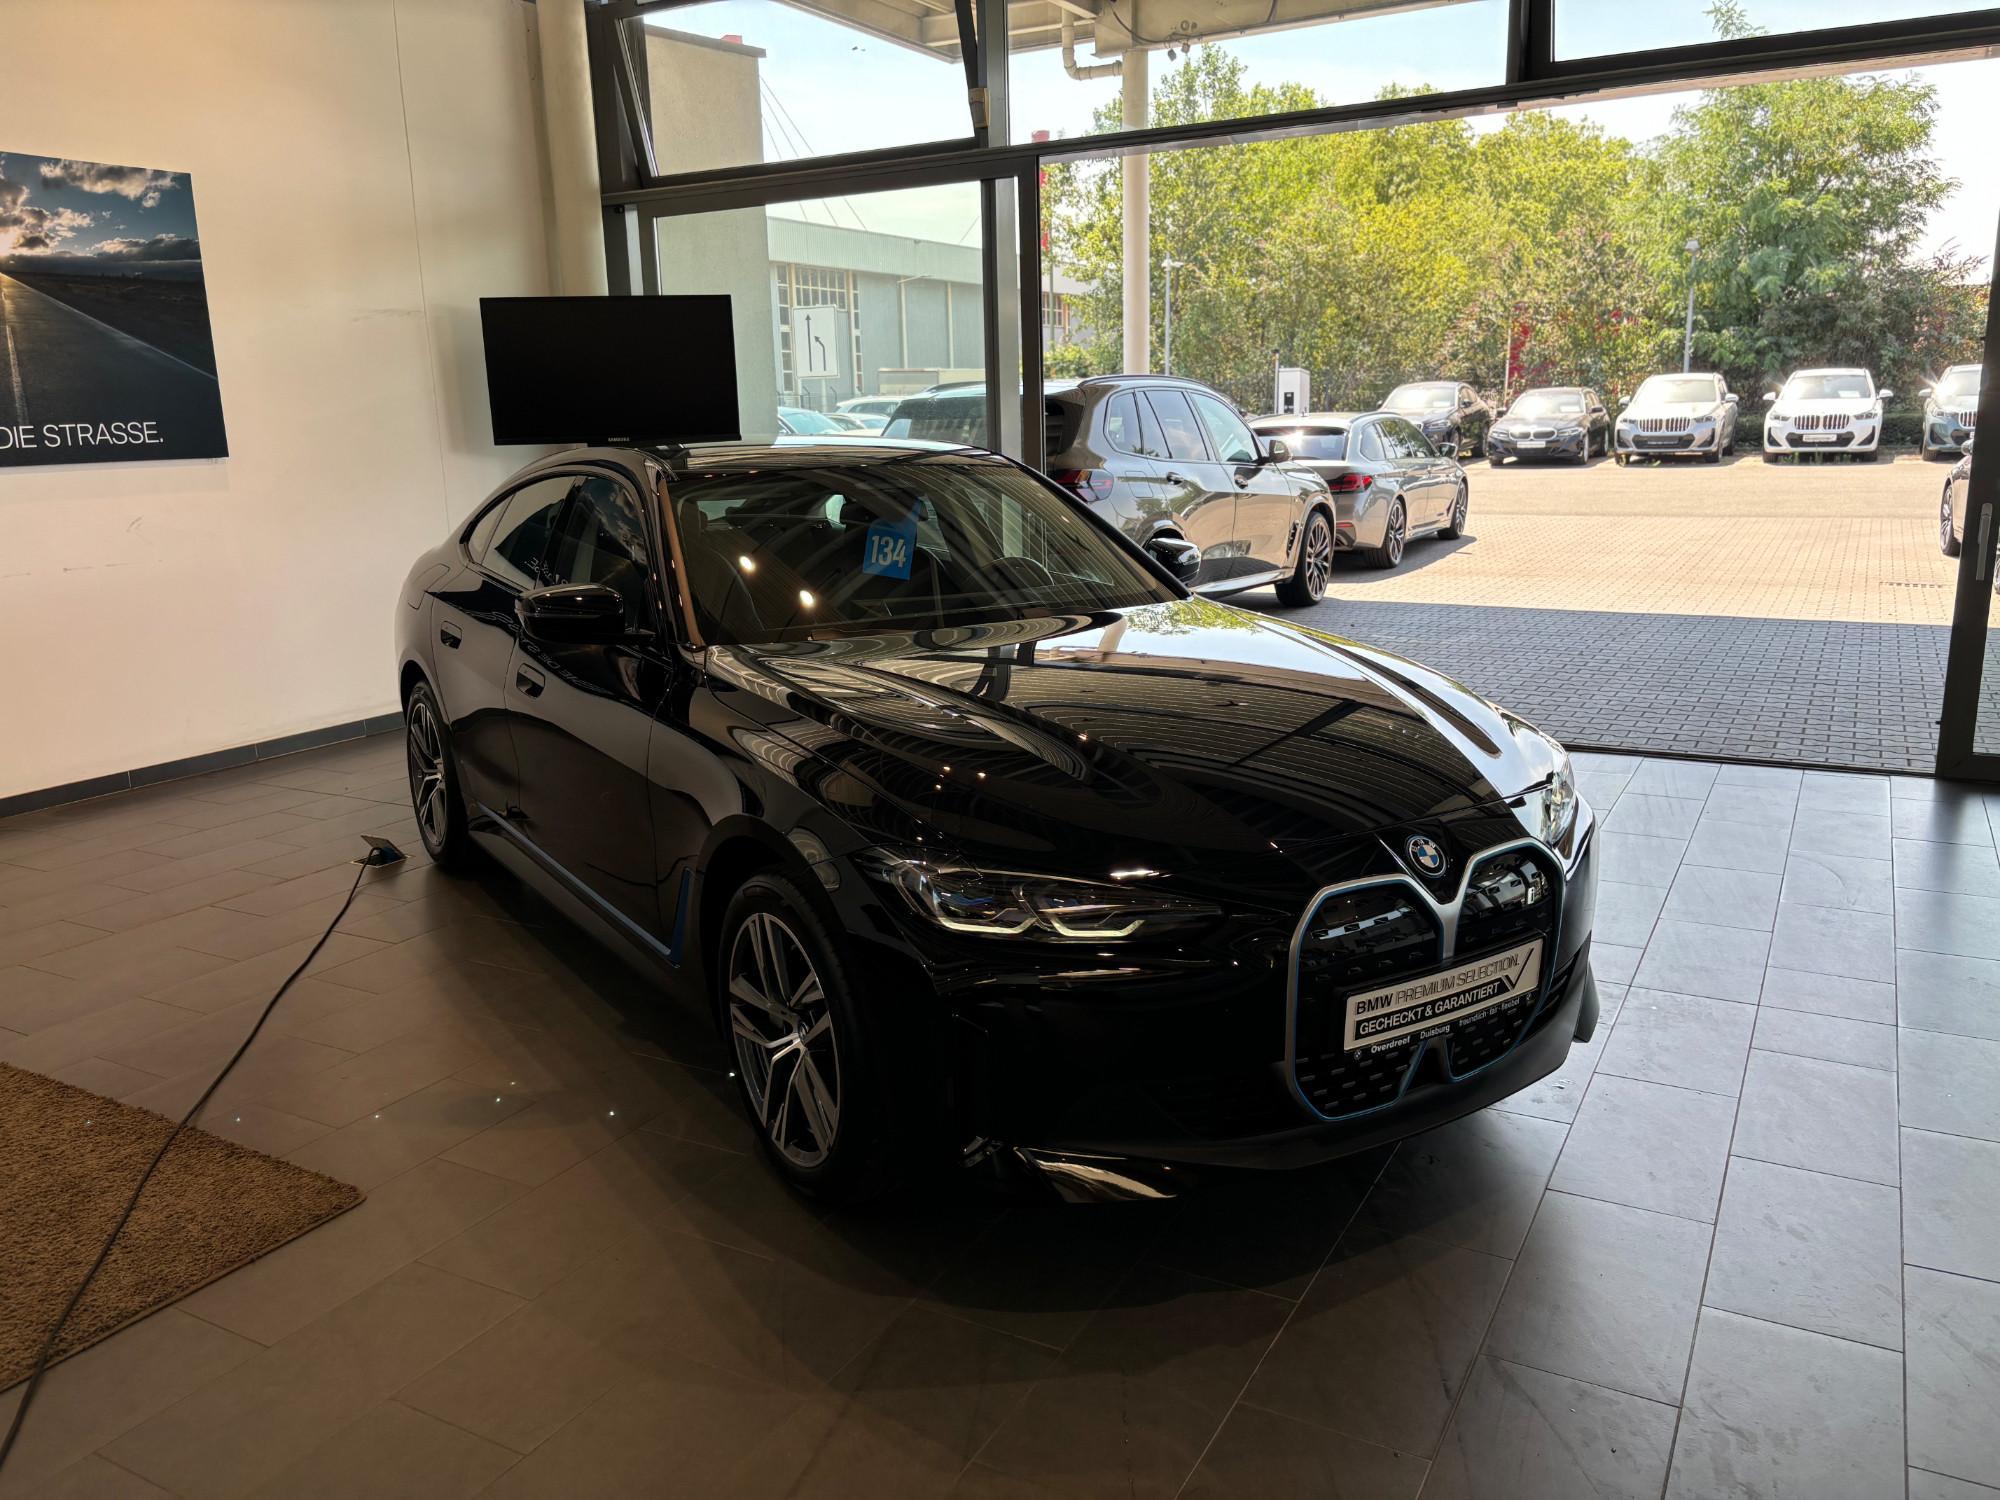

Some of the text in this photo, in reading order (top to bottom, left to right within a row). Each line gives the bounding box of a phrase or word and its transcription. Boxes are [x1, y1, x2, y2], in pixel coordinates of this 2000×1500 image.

[0, 421, 164, 449] DIE STRASSE.
[871, 535, 907, 569] 134
[1356, 993, 1394, 1015] BMW
[1396, 976, 1455, 1004] PREMIUM
[1359, 981, 1501, 1035] GECHECKT & GARANTIERT
[1420, 1024, 1451, 1039] Duisburg
